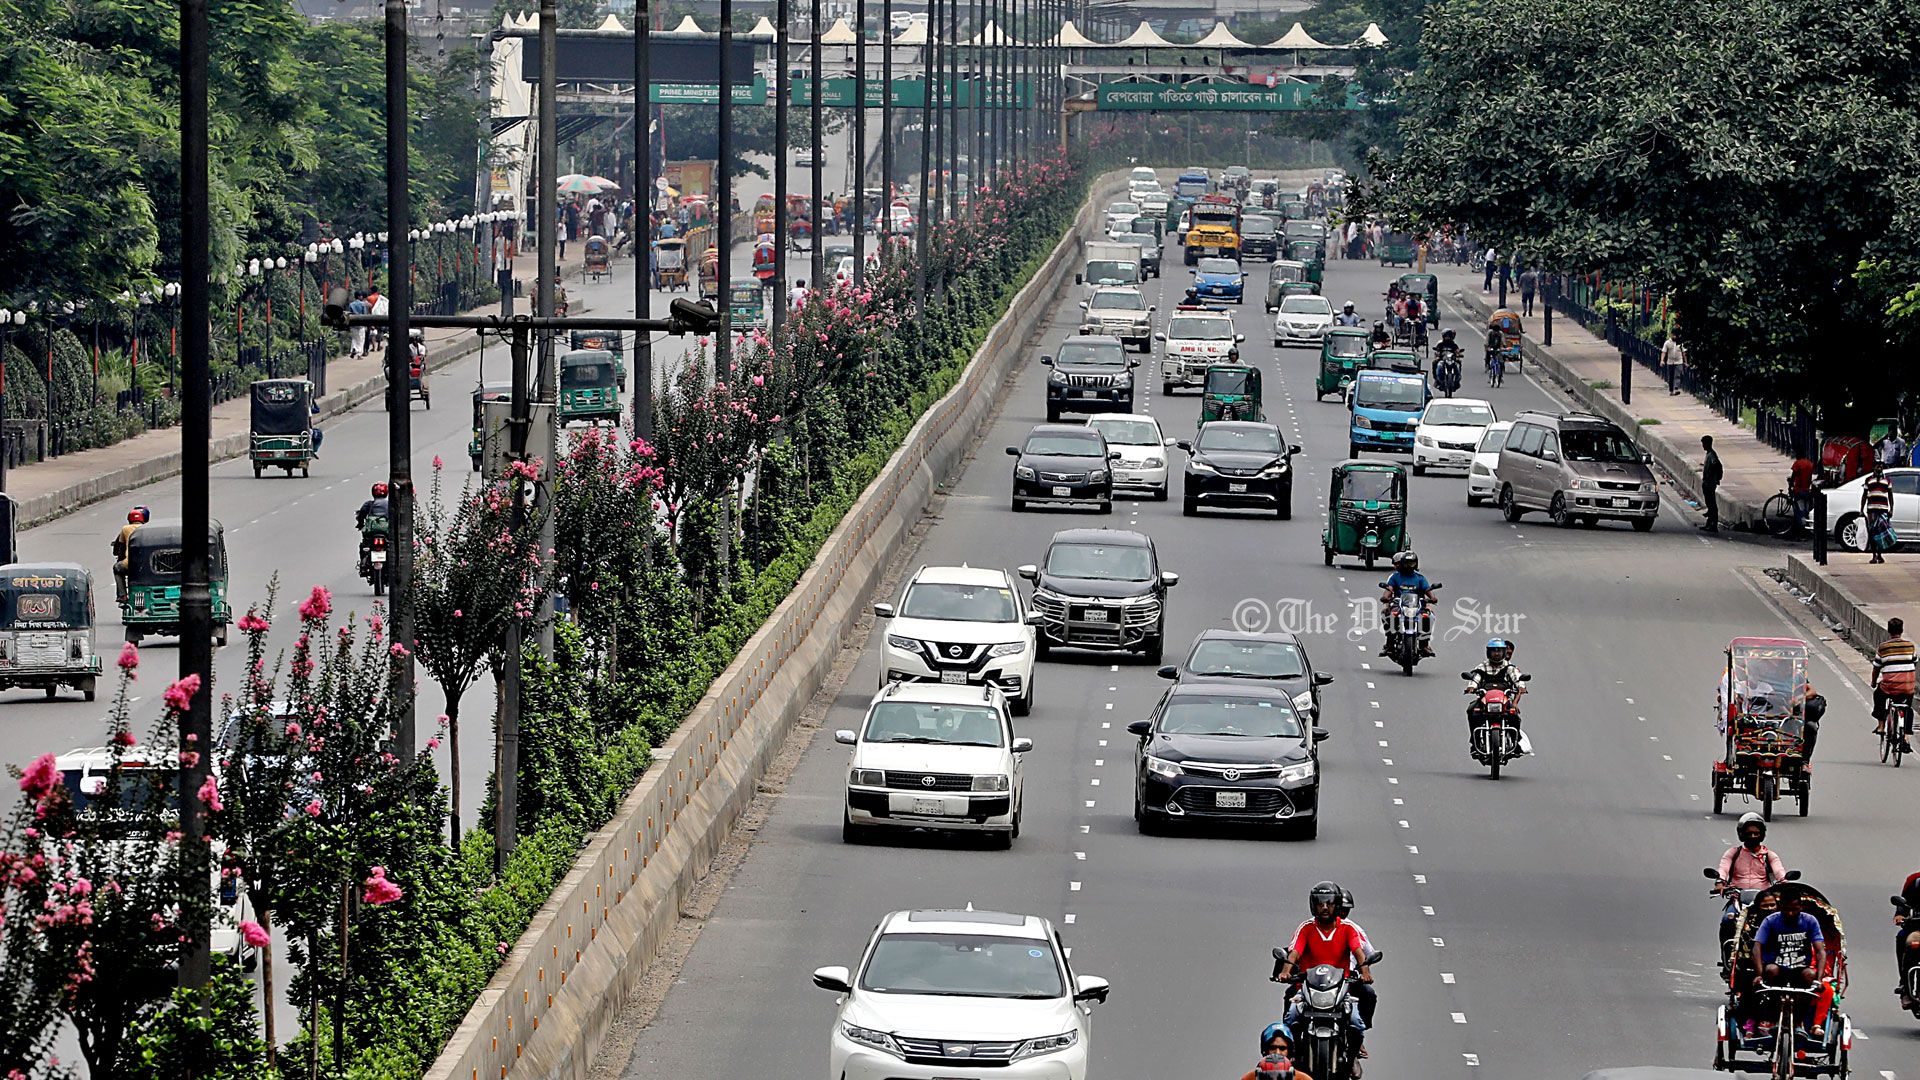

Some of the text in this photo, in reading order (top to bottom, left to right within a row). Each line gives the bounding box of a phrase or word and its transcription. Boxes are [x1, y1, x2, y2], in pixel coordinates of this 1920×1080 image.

[659, 88, 682, 96] PRIME
[731, 89, 752, 97] FFICE
[1106, 91, 1154, 103] বেপরোয়া
[1158, 88, 1194, 103] গতিতে
[1195, 88, 1219, 105] গাড়ী
[1220, 90, 1262, 104] চালাবেন
[12, 573, 67, 589] প্রাইভেট
